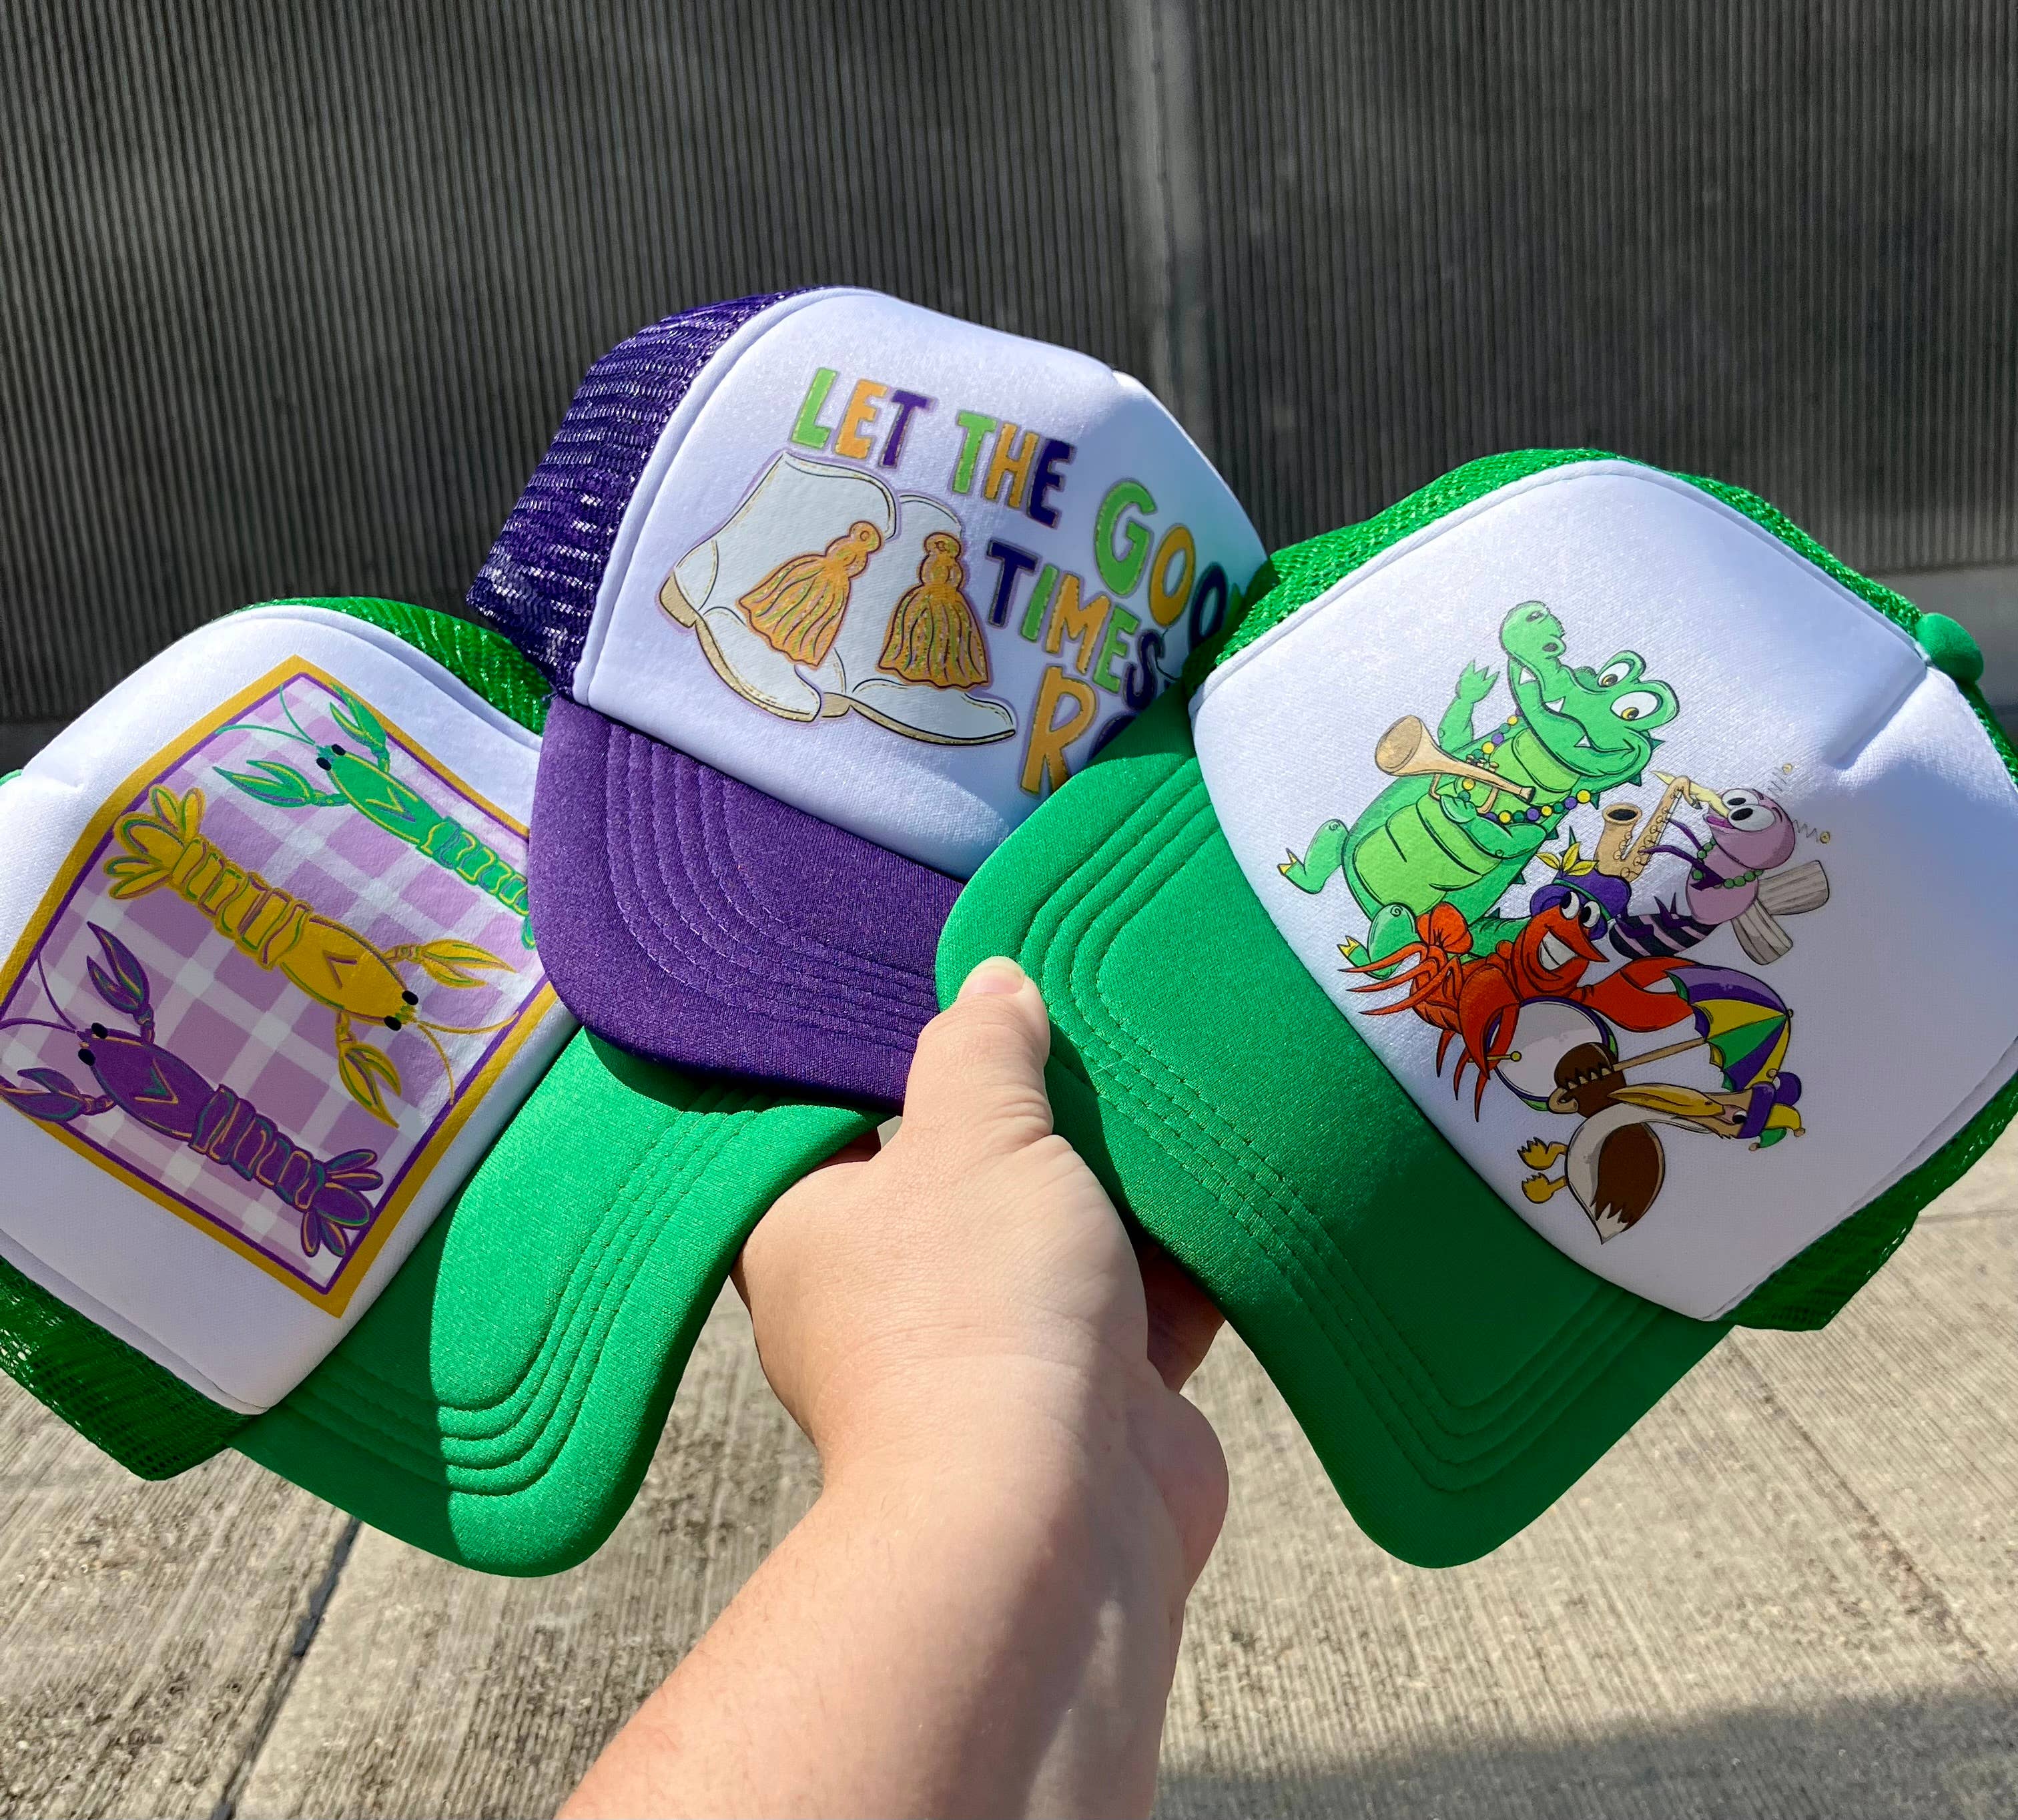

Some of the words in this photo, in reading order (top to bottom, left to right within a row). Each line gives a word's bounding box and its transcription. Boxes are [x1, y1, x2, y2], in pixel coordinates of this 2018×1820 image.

[790, 367, 929, 468] LET
[952, 410, 1076, 529] THE
[1094, 481, 1244, 650] GOO
[986, 539, 1164, 710] TIMES
